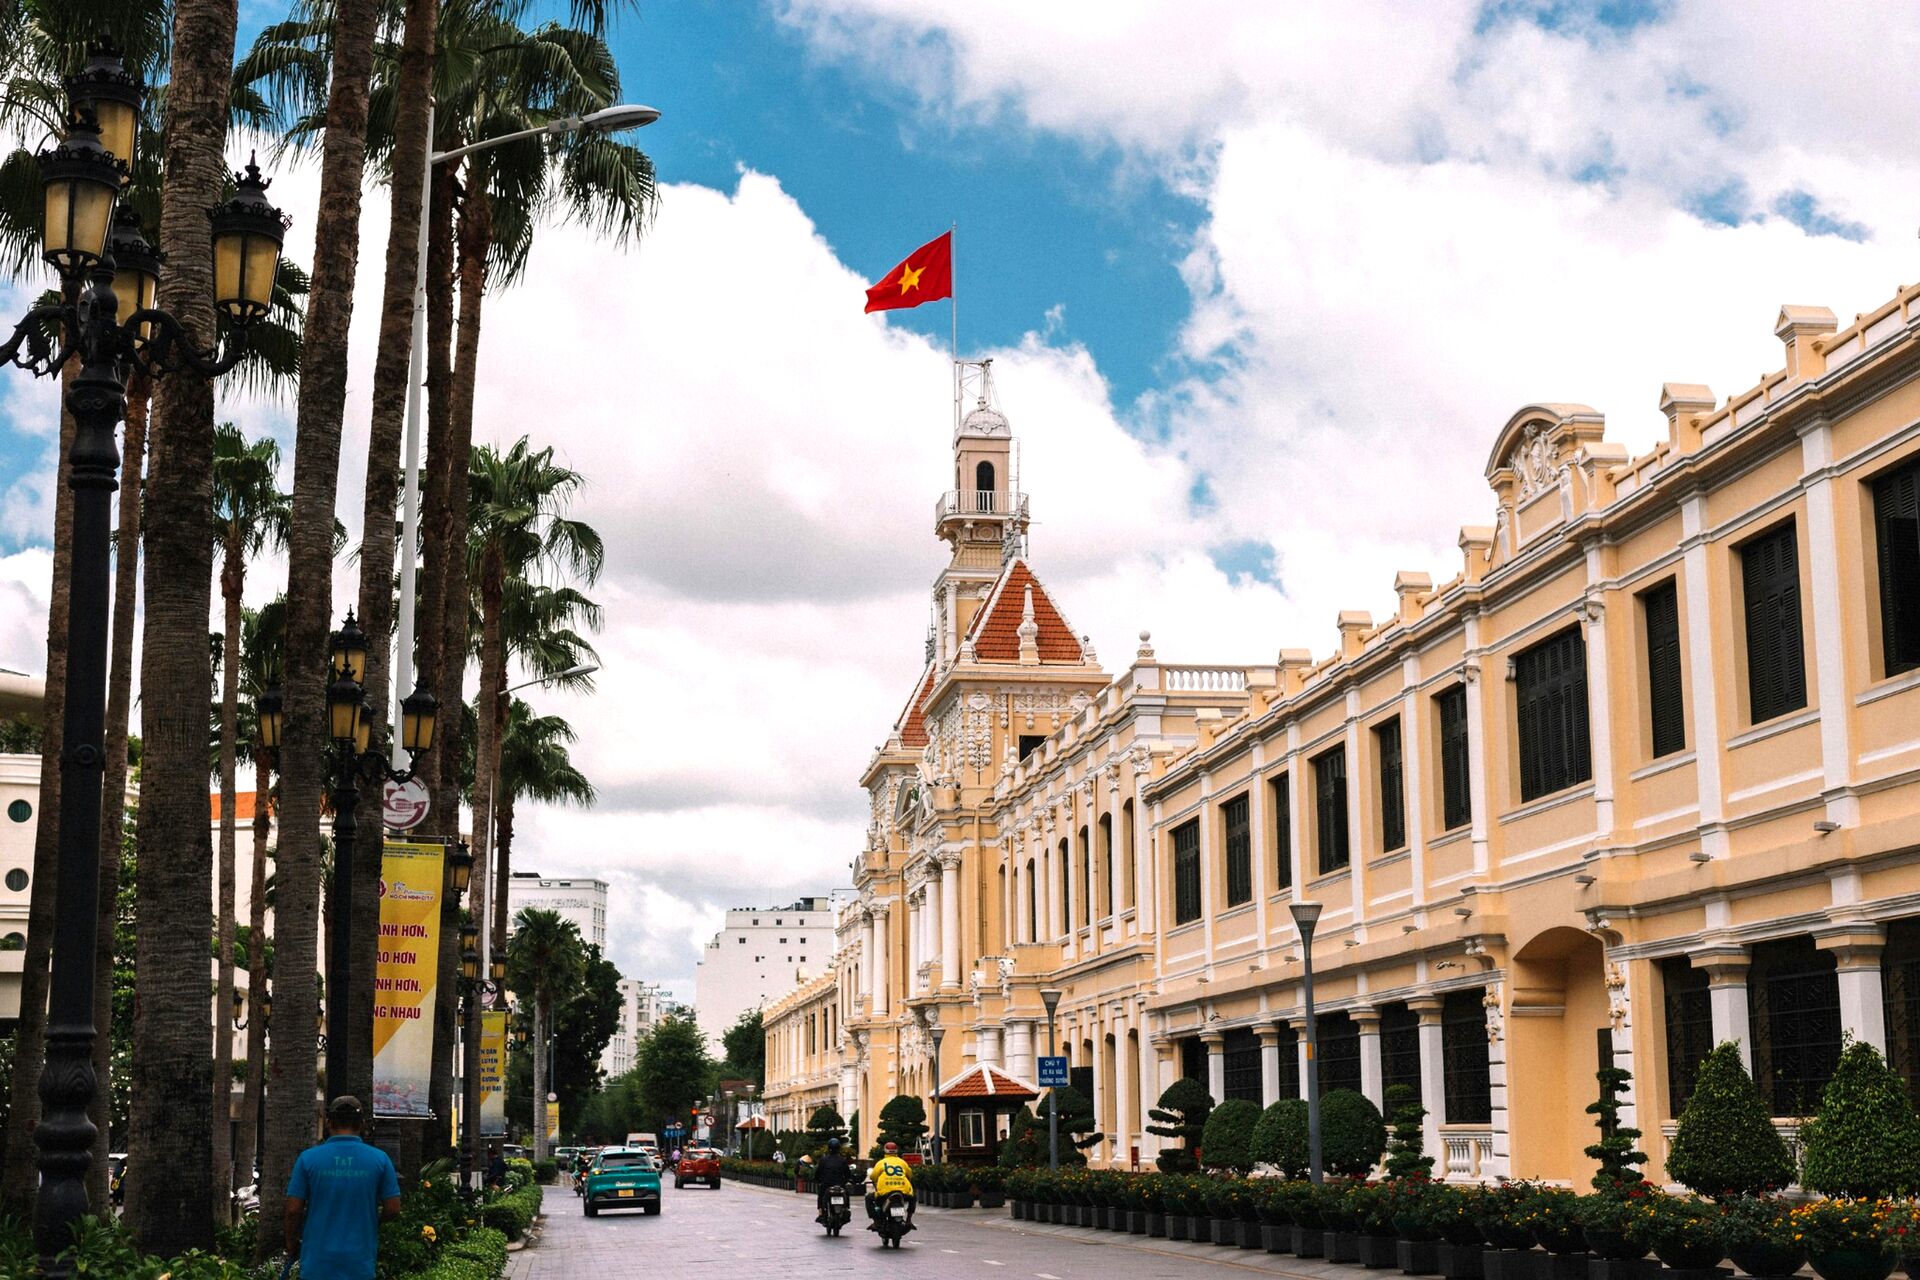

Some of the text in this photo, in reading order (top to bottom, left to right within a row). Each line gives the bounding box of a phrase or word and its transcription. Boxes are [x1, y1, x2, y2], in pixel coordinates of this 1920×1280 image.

[401, 924, 428, 938] HƠN,
[393, 951, 416, 964] HƠN
[390, 1006, 421, 1019] NHAU
[884, 1162, 903, 1176] be
